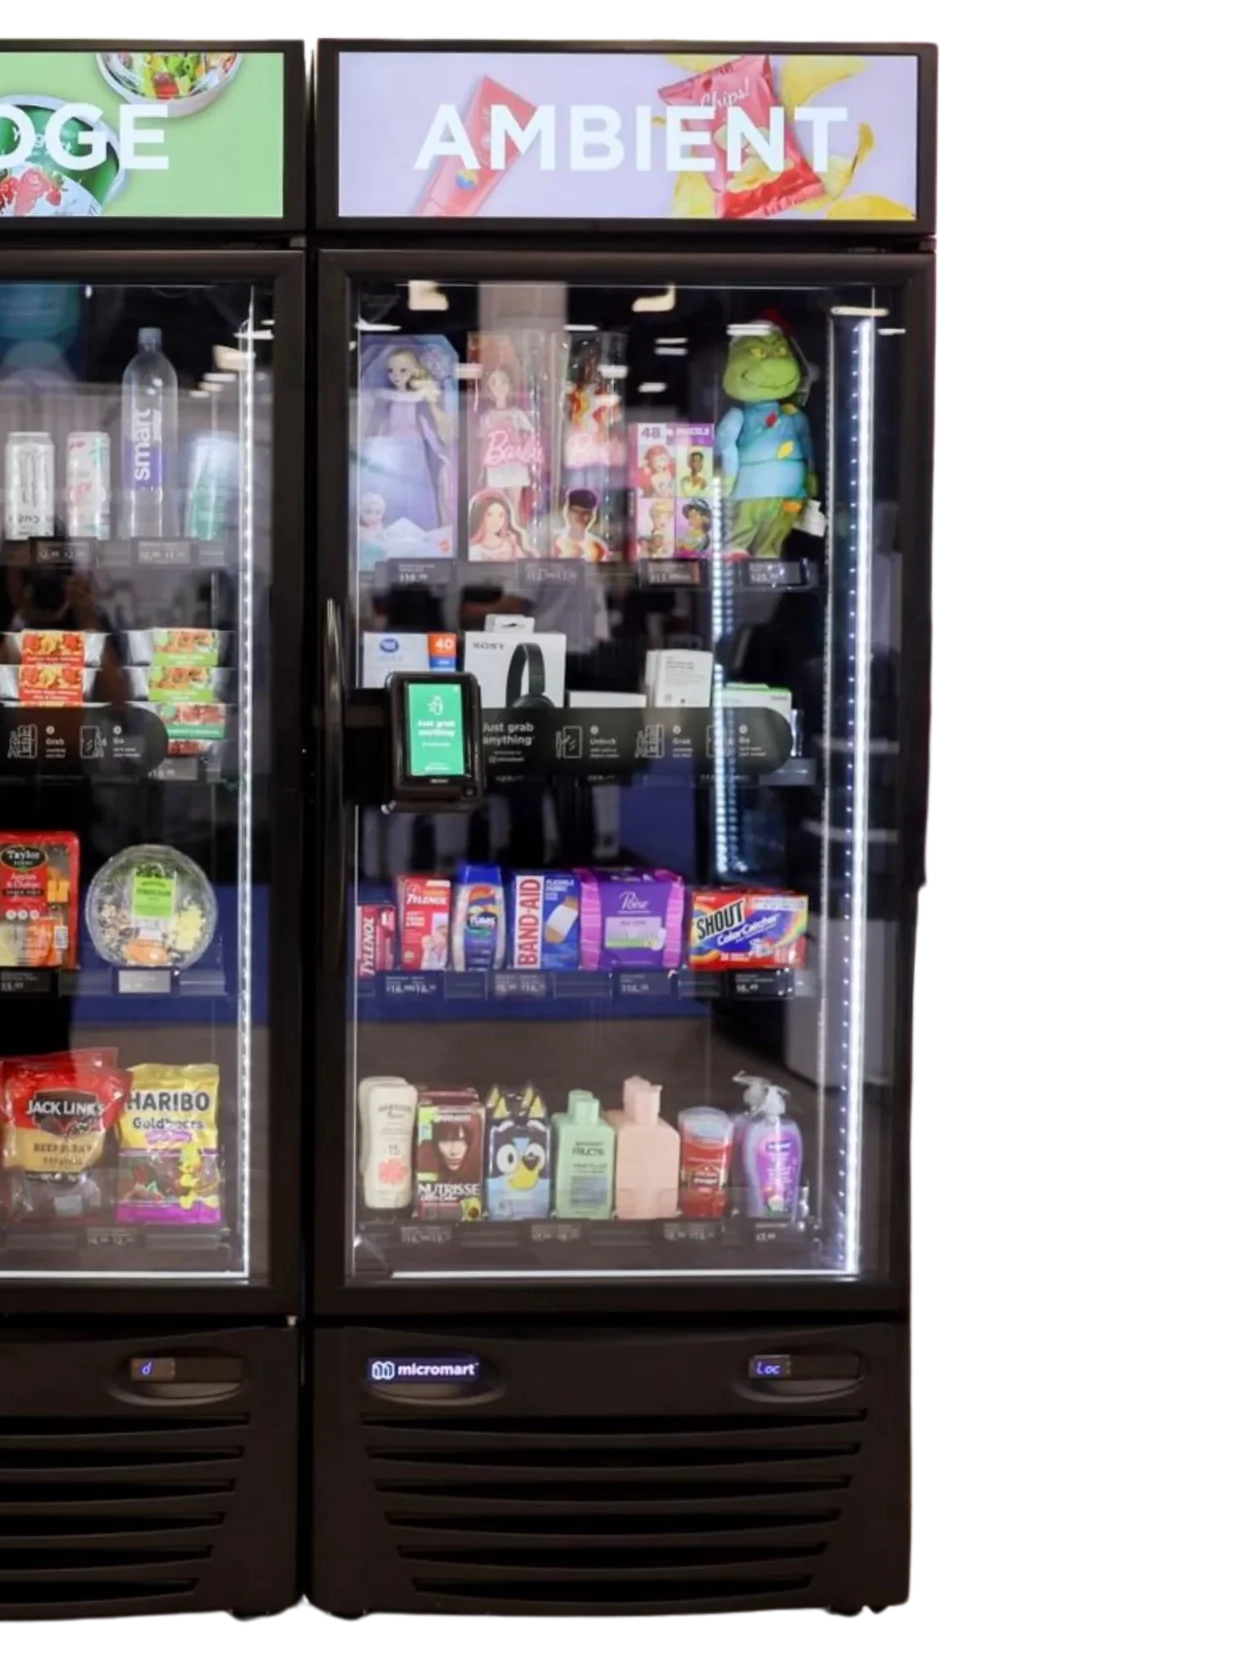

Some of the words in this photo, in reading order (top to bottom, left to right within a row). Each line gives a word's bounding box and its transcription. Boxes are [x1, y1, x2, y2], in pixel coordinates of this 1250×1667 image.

[413, 105, 847, 172] AMBIENT
[641, 427, 660, 438] 48
[134, 408, 150, 481] smart
[483, 722, 504, 732] Just
[507, 722, 534, 734] grab
[482, 735, 533, 746] anything
[6, 850, 40, 861] Taylor
[407, 894, 447, 905] TYLENOL
[619, 891, 649, 910] Poise
[518, 879, 541, 966] BAND-AID
[697, 900, 743, 940] SHOUT
[360, 917, 375, 976] TYLENOL
[26, 1100, 62, 1115] JACK
[127, 1091, 210, 1112] HARIBO
[418, 1183, 479, 1197] NUTRISSE
[398, 1361, 474, 1376] micromart
